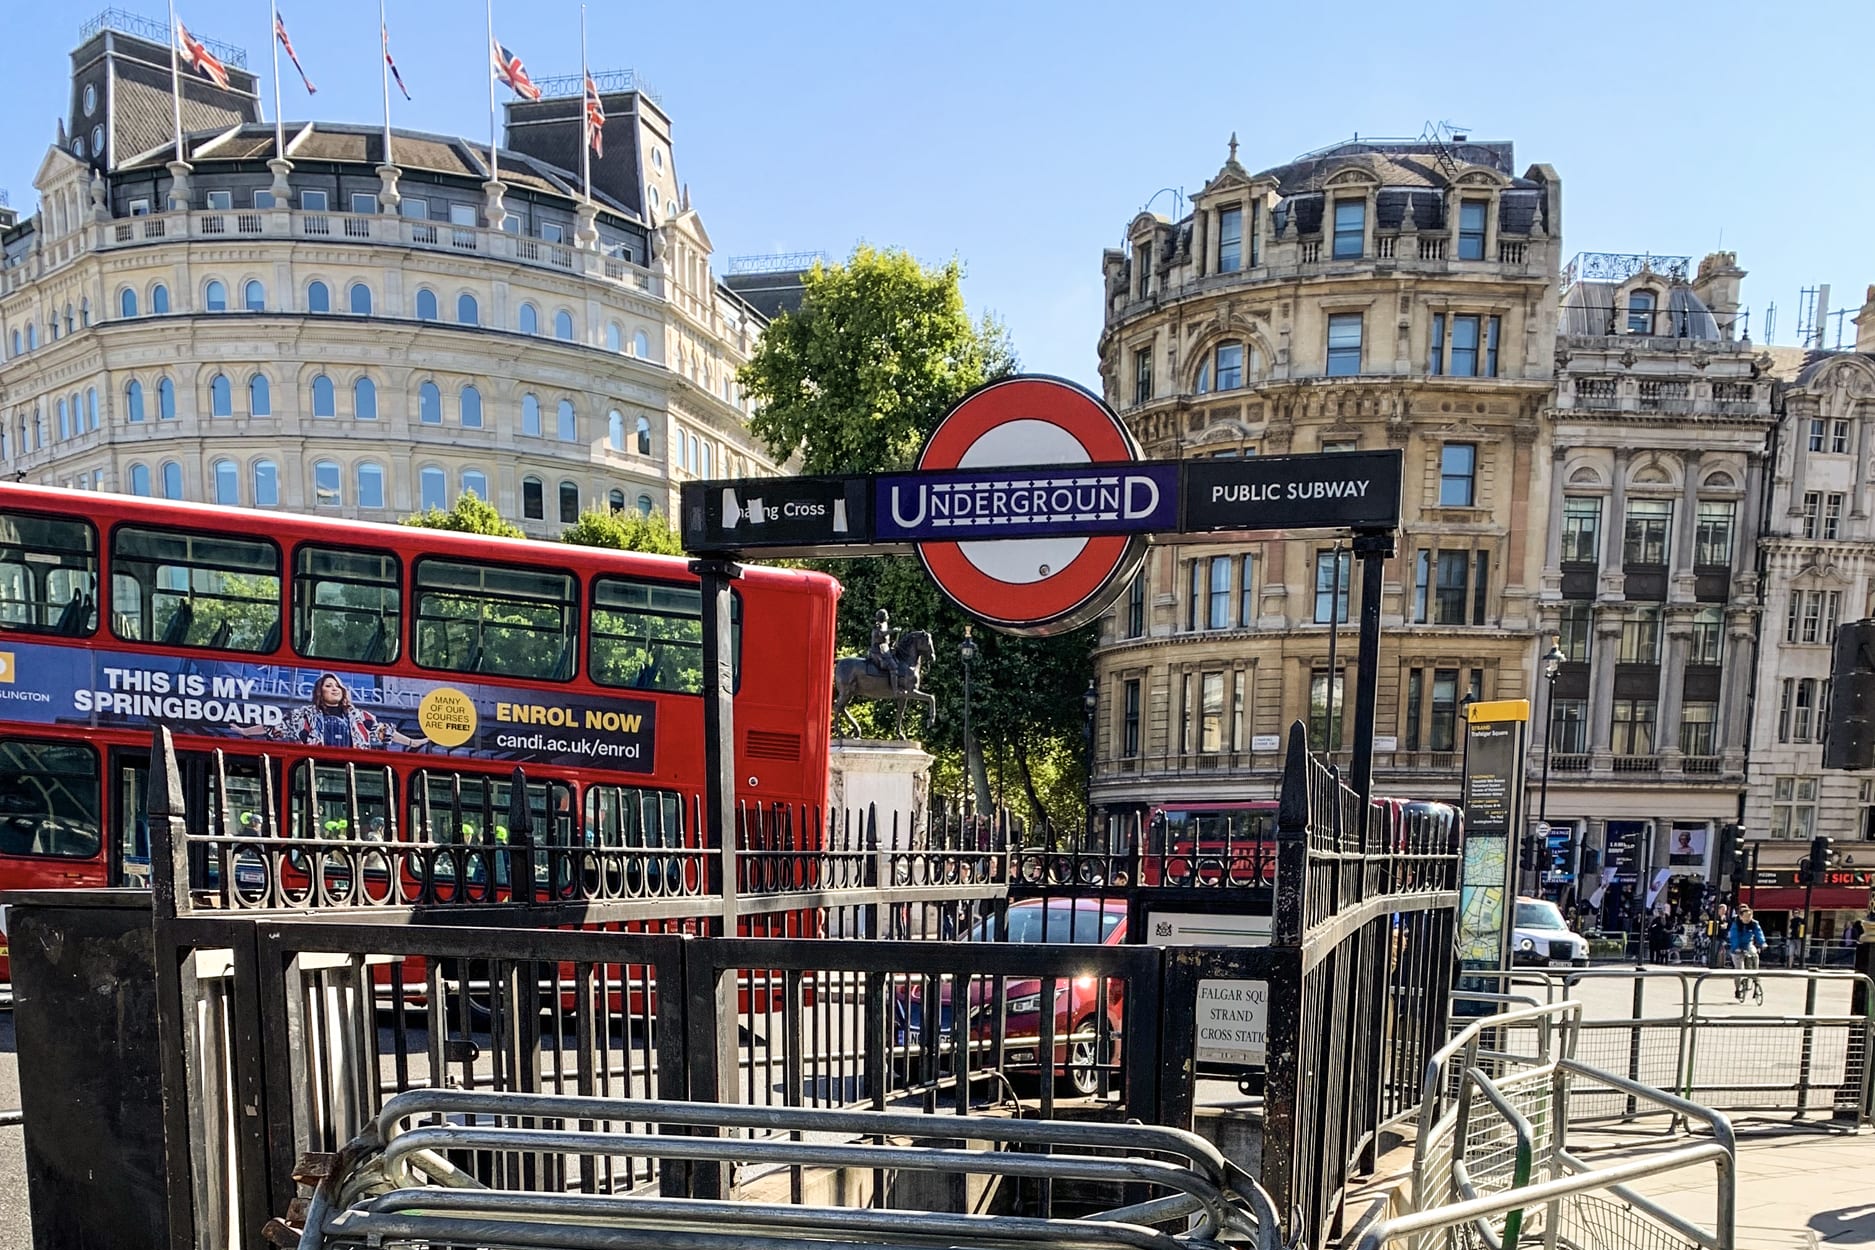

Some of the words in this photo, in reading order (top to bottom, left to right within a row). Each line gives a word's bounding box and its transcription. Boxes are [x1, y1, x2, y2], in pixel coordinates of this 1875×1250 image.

[1212, 483, 1281, 503] PUBLIC
[1286, 480, 1370, 500] SUBWAY
[891, 475, 1159, 528] UNDERGROUND
[784, 503, 825, 517] Cross
[103, 667, 171, 694] THIS
[178, 674, 206, 697] IS
[212, 677, 256, 700] MY
[74, 689, 284, 726] SPRINGBOARD
[435, 696, 461, 705] MANY
[430, 704, 443, 712] OF
[445, 705, 465, 714] OUR
[426, 712, 470, 723] COURSES
[496, 702, 579, 728] ENROL
[585, 710, 642, 734] NOW
[425, 721, 444, 730] ARE
[446, 722, 471, 731] FREE!
[496, 734, 640, 758] candi.ac.uk/enrol
[1832, 873, 1872, 883] SICIY
[1199, 987, 1242, 1001] FALGAR
[1246, 989, 1266, 1005] SQU
[1210, 1008, 1254, 1022] STRAND
[1200, 1028, 1232, 1041] CROSS
